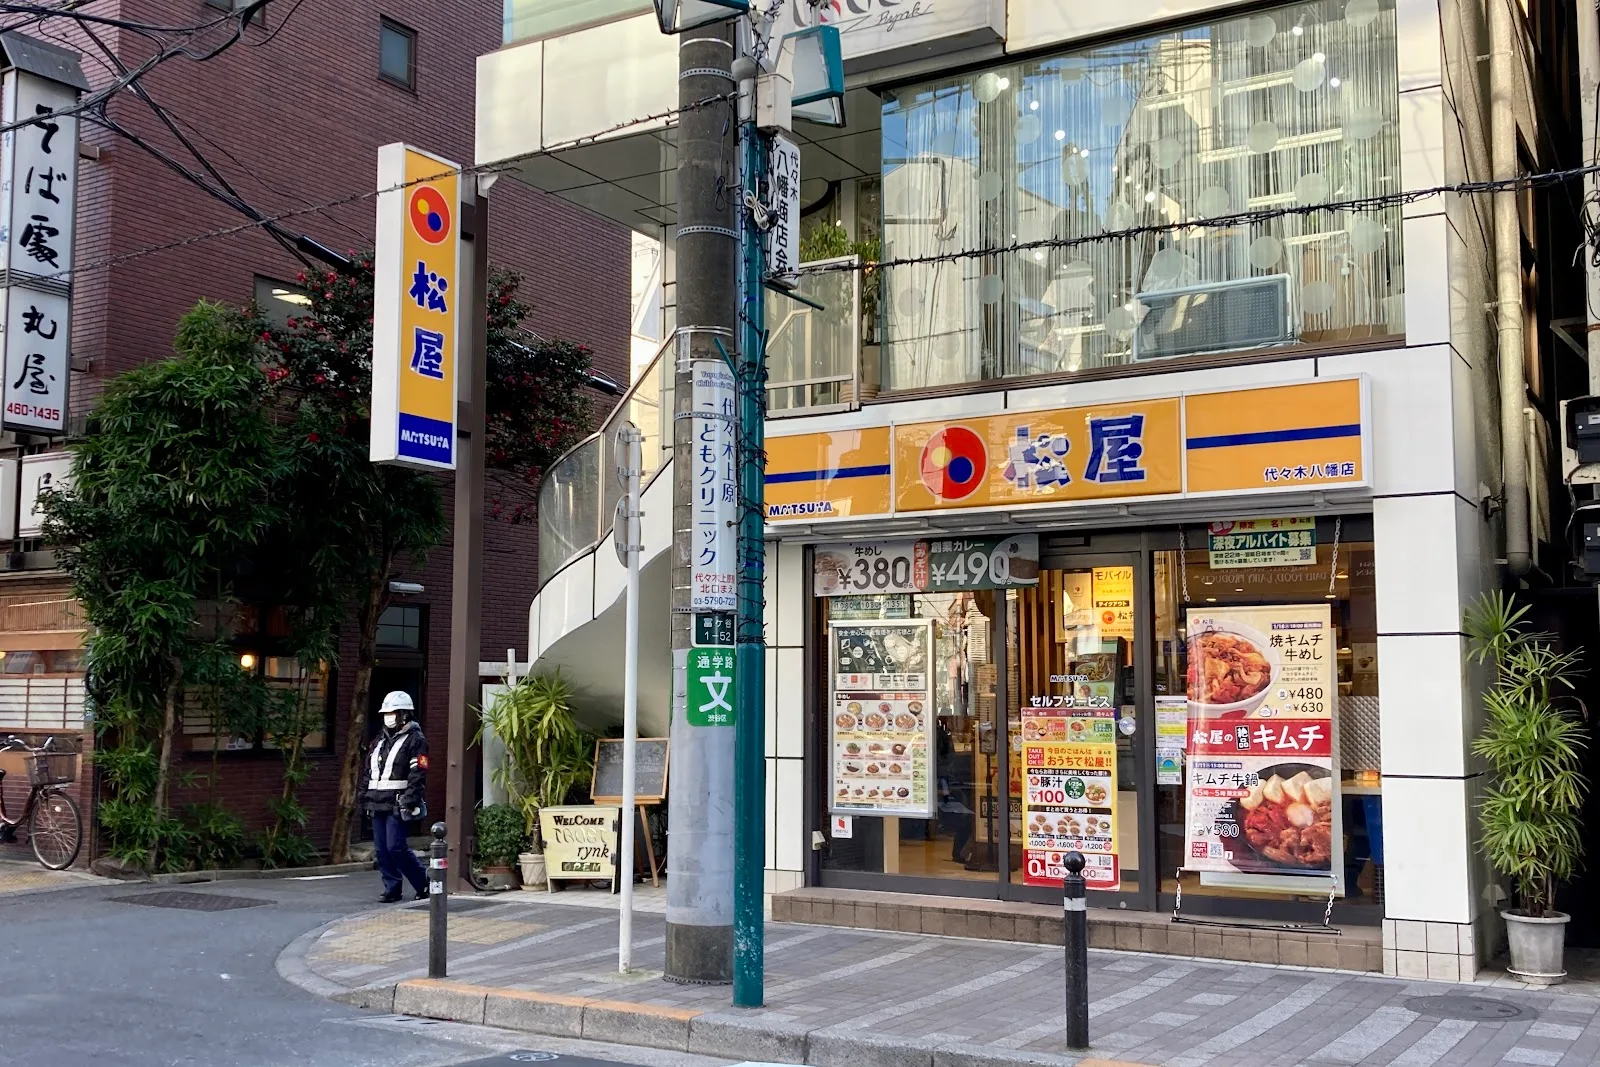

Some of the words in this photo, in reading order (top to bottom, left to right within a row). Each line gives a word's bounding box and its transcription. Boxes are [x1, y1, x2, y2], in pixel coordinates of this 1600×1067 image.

[790, 151, 799, 201] 代々木
[408, 261, 449, 381] 松屋
[13, 305, 57, 395] 丸屋
[6, 402, 60, 421] 460-1435
[401, 429, 450, 450] MATSUYA
[1003, 414, 1145, 489] 松屋
[1264, 461, 1355, 482] 代々木八幡店
[769, 501, 833, 516] MATSUYA
[931, 541, 985, 554] 創業カレー
[1212, 531, 1312, 550] 深夜アルバイト募集
[855, 547, 883, 556] 牛めし
[1269, 634, 1323, 648] 焼キムチ
[1284, 648, 1323, 661] 牛めし
[697, 656, 733, 669] 通学路
[699, 671, 733, 712] 文
[1289, 687, 1323, 700] ¥480
[1029, 695, 1111, 708] セルフサービス
[1293, 702, 1324, 712] ¥630
[1252, 724, 1324, 751] キムチ
[1040, 776, 1063, 788] 豚汁
[1193, 772, 1259, 786] キムチ牛鍋
[1205, 824, 1240, 837] ¥580
[577, 844, 609, 860] rynk
